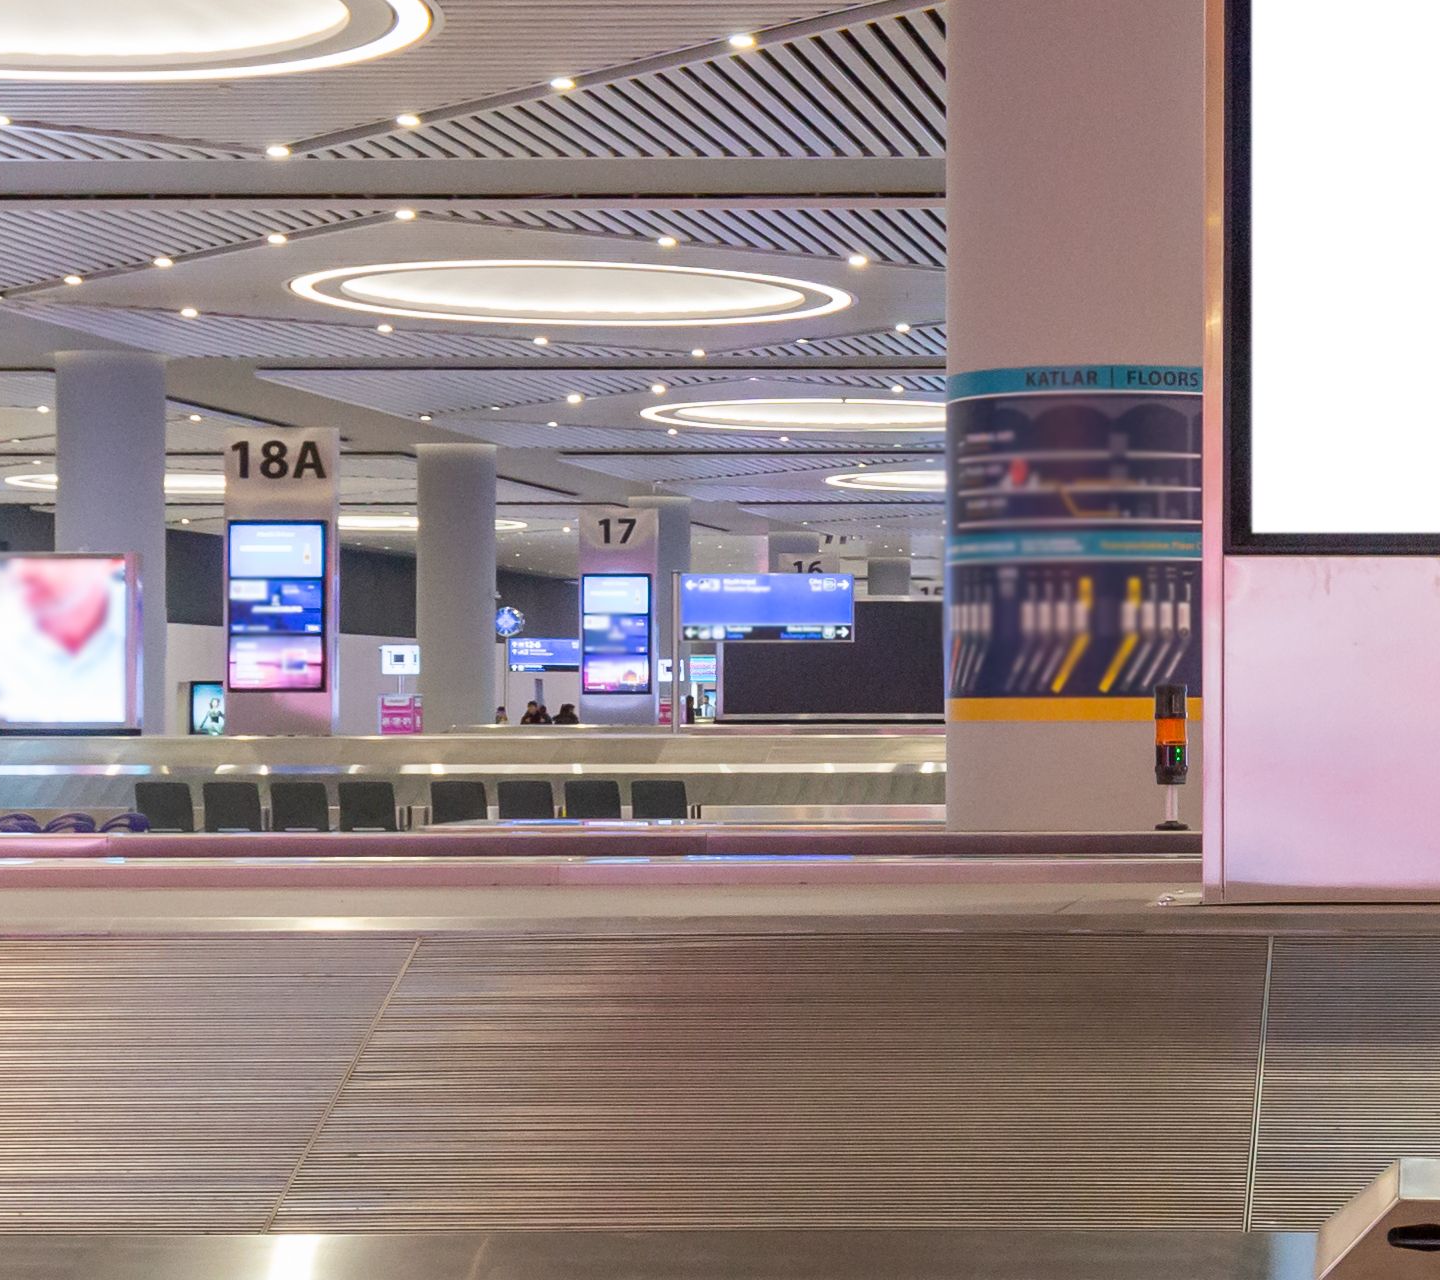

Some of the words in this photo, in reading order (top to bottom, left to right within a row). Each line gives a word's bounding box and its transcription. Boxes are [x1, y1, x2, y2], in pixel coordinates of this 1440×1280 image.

[1025, 371, 1098, 387] KATLAR
[1126, 371, 1199, 387] FLOORS
[231, 440, 327, 479] 18A
[598, 518, 637, 544] 17
